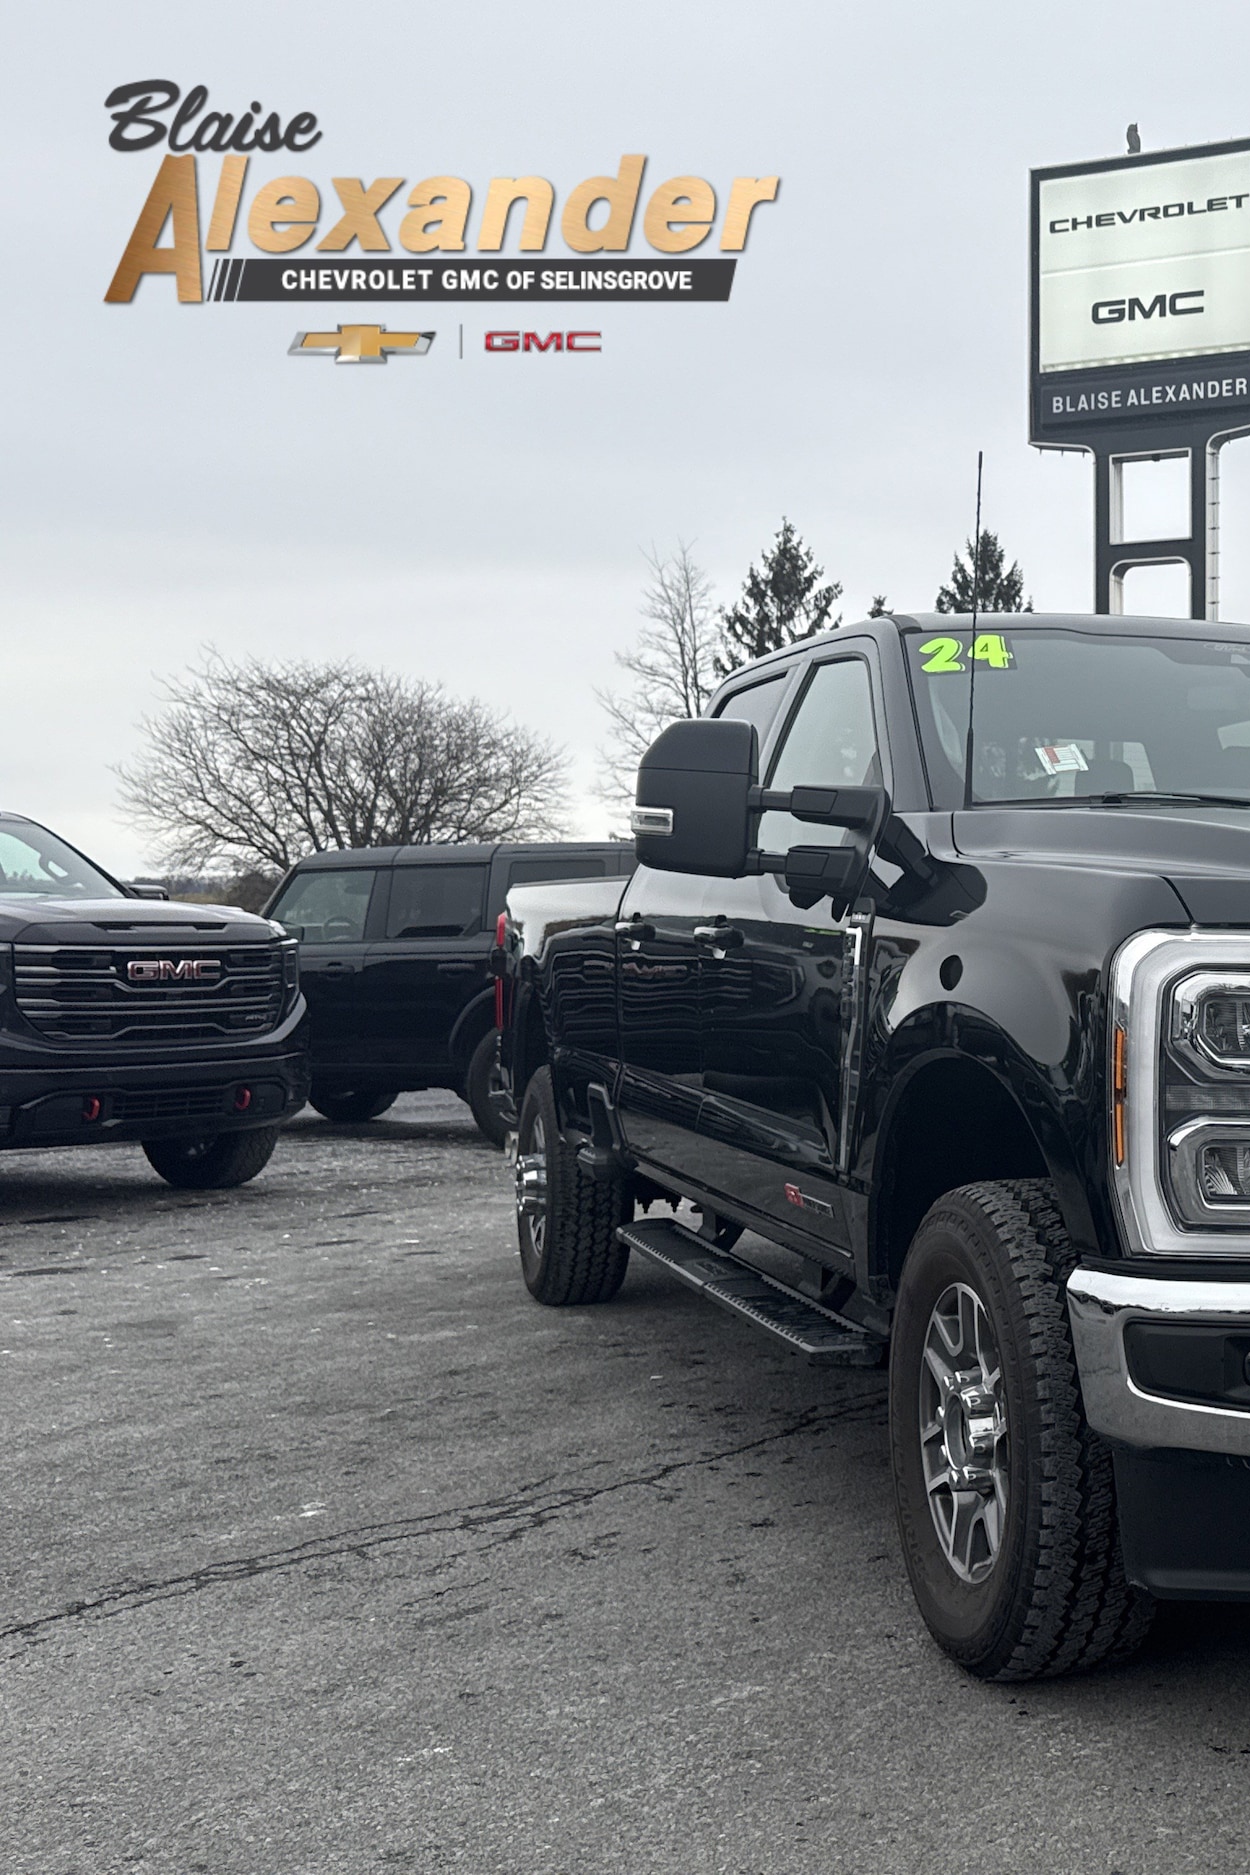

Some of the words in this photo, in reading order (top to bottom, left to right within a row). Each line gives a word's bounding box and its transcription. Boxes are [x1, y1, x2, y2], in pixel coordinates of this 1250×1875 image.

[1049, 193, 1250, 234] CHEVROLET
[1091, 290, 1205, 325] GMC
[1052, 391, 1122, 414] BLAISE
[1127, 377, 1248, 407] ALEXANDER
[918, 634, 1014, 673] 24
[127, 959, 222, 981] GMC
